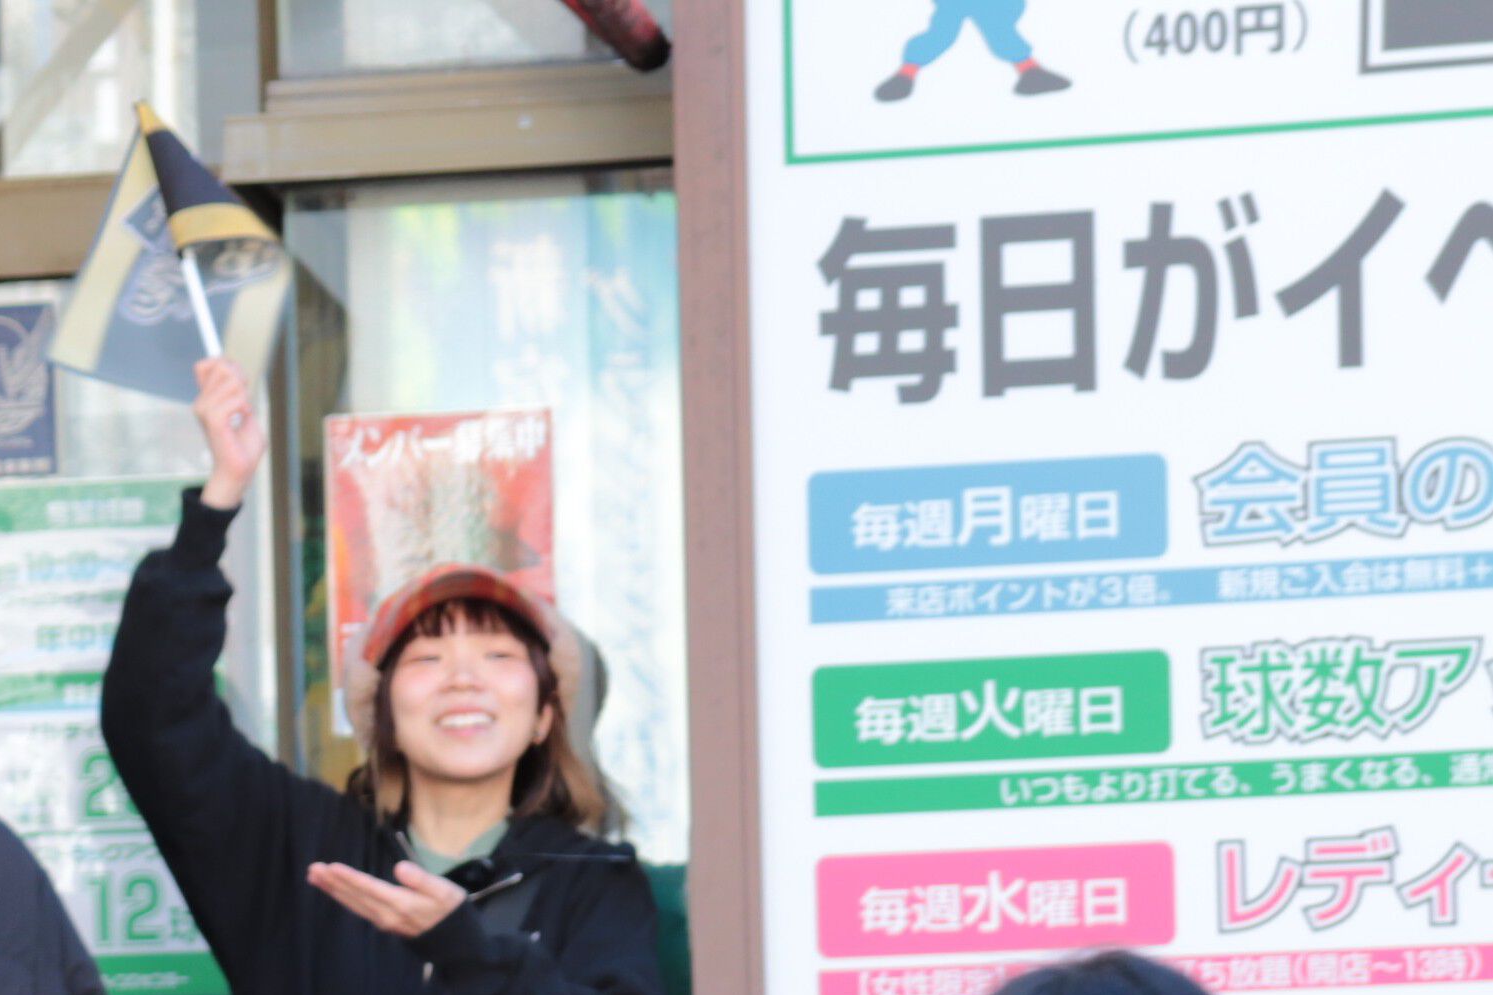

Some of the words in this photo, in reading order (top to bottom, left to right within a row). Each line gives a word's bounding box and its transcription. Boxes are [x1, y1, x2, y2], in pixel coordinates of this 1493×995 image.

[850, 486, 1122, 551] 毎週月曜日
[1193, 435, 1493, 549] 会員の
[885, 573, 1172, 618] 来店ポイントが3倍。
[853, 678, 1125, 746] 毎週火曜日
[1199, 634, 1493, 746] 球数ア
[859, 871, 1128, 935] 毎週水曜日
[1217, 827, 1493, 934] レディ
